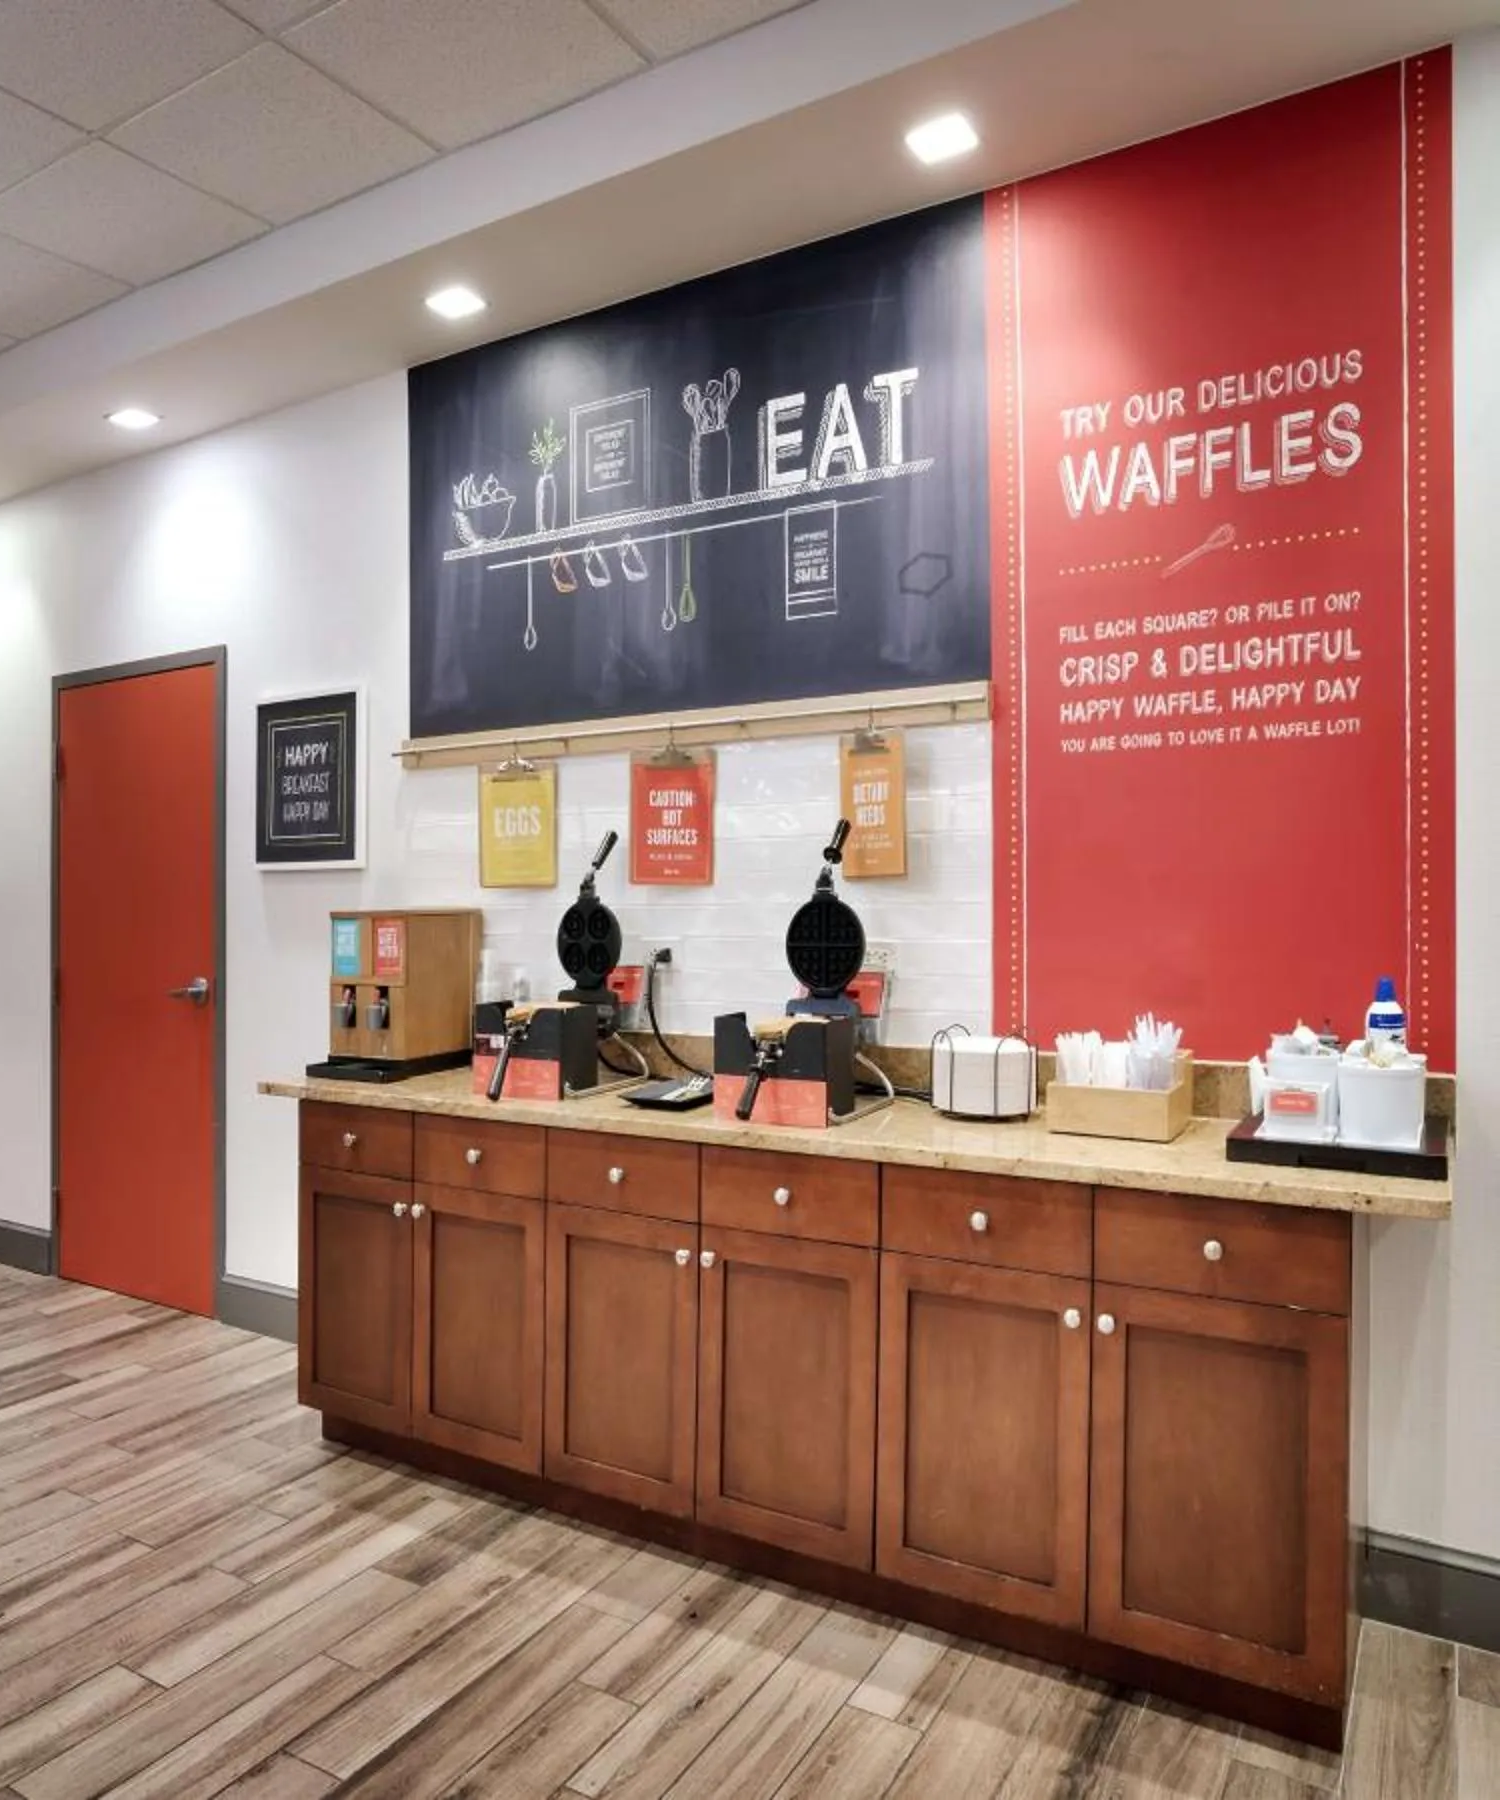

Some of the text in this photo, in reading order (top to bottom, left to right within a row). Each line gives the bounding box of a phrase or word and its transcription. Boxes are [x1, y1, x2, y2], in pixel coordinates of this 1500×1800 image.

[1060, 349, 1363, 439] TRY OUR DELICIOUS
[757, 367, 919, 490] EAT
[1059, 402, 1363, 517] WAFFLES
[1059, 591, 1361, 644] FILL EACH SQUARE? OR PILE IT ON?
[1060, 628, 1362, 687] CRISP & DELIGHTFUL
[1060, 675, 1361, 724] HAPPY WAFFLE, HAPPY DAY
[284, 742, 329, 767] HAPPY
[1061, 738, 1085, 753] YOU
[1089, 736, 1117, 751] ARE
[1120, 732, 1162, 750] GOING
[1168, 730, 1185, 746] TO
[1189, 727, 1225, 745] LOVE
[1230, 726, 1242, 742] IT
[1248, 725, 1258, 741] A
[1264, 720, 1321, 740] WAFFLE
[494, 805, 542, 837] EGGS
[646, 828, 699, 845] SURFACES
[663, 809, 682, 826] HOT
